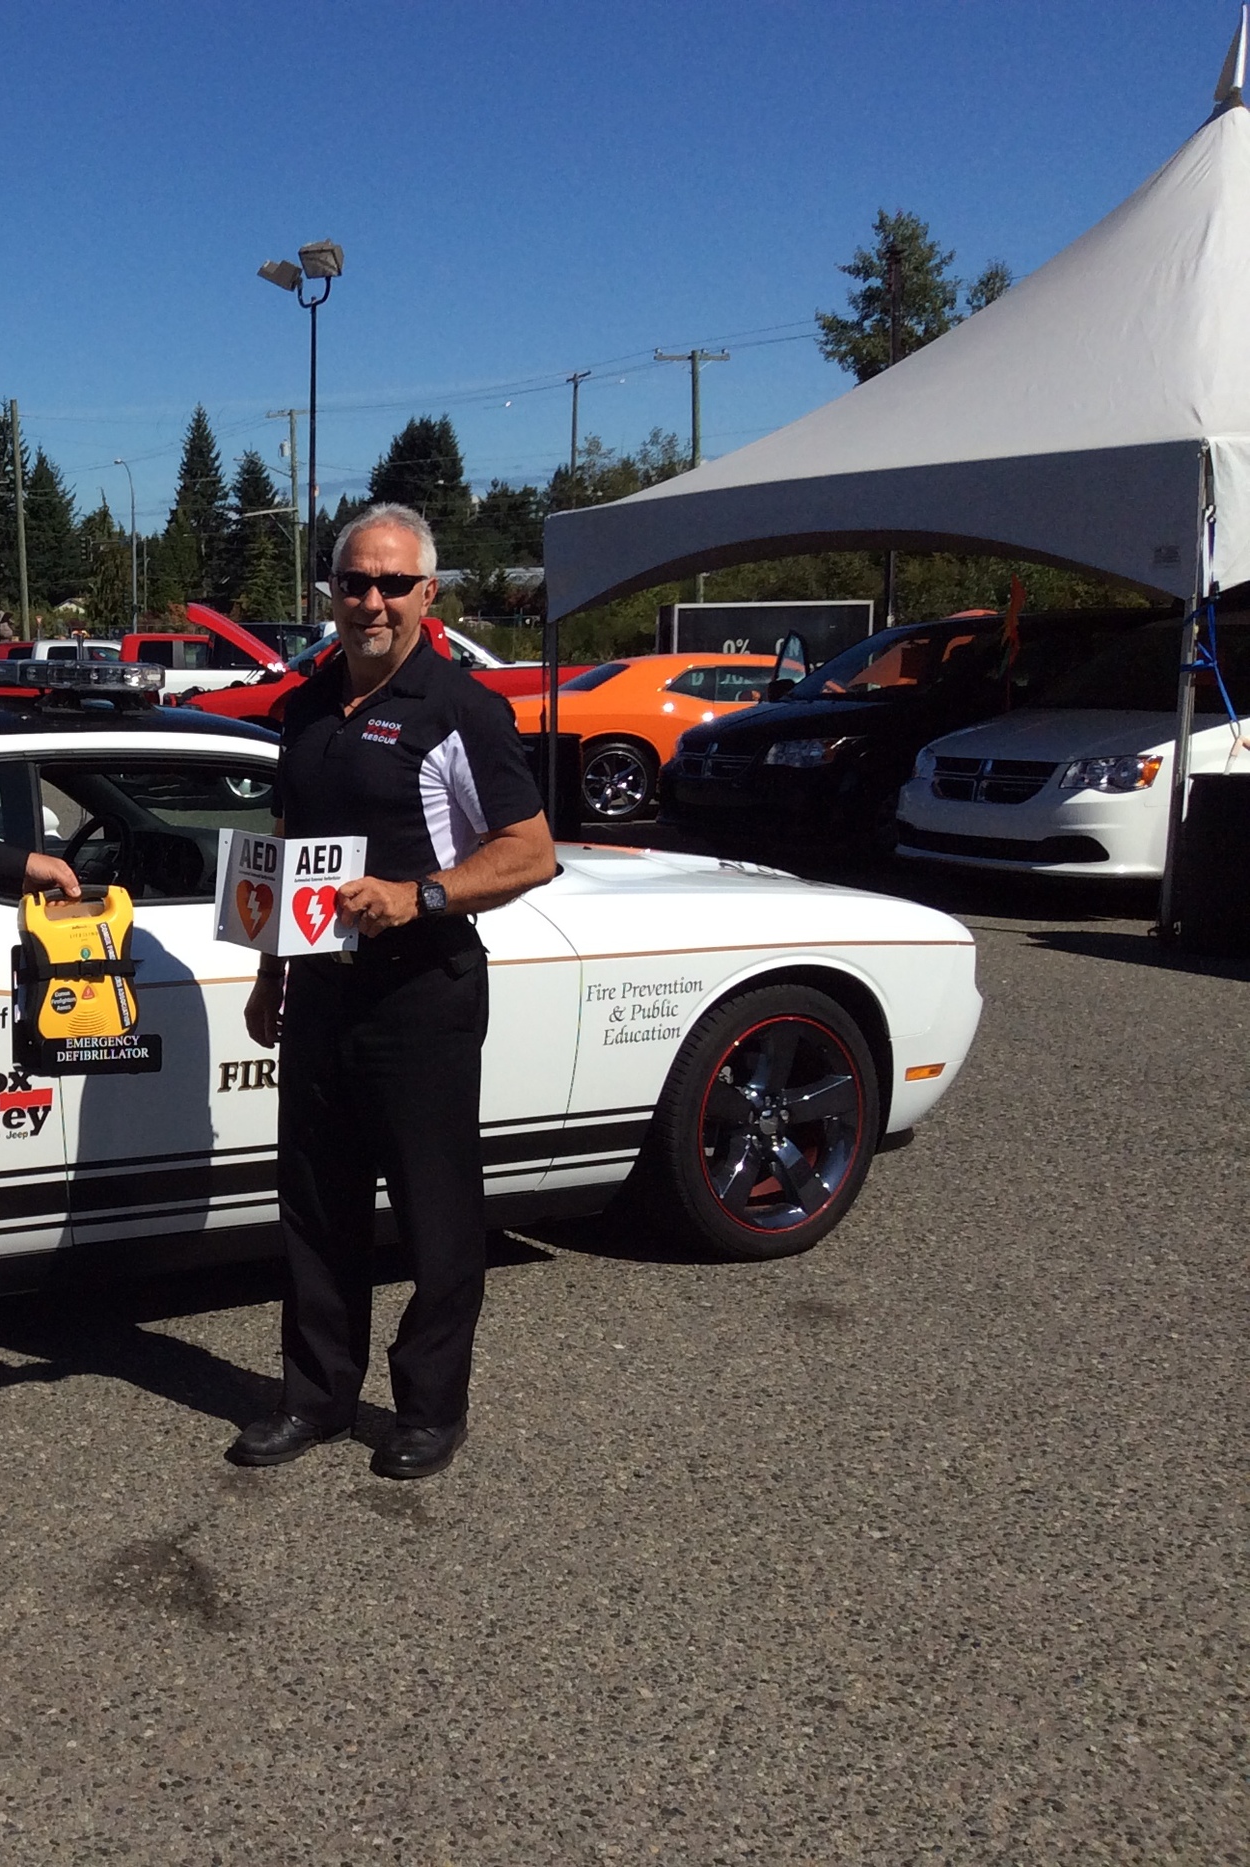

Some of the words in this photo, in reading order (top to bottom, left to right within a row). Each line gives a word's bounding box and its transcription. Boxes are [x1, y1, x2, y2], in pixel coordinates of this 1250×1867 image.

[367, 719, 402, 730] COMOX
[361, 732, 397, 745] RESCUE
[239, 838, 277, 873] AED
[295, 844, 342, 875] AED
[586, 983, 616, 1002] Fire
[621, 976, 703, 999] Prevention
[609, 1005, 626, 1022] &
[630, 998, 679, 1021] Public
[66, 1035, 141, 1049] EMERGENCY
[603, 1023, 681, 1046] Education
[57, 1047, 149, 1063] DEFIBRILLATOR
[217, 1058, 278, 1093] FIR
[6, 1131, 28, 1140] Jeep
